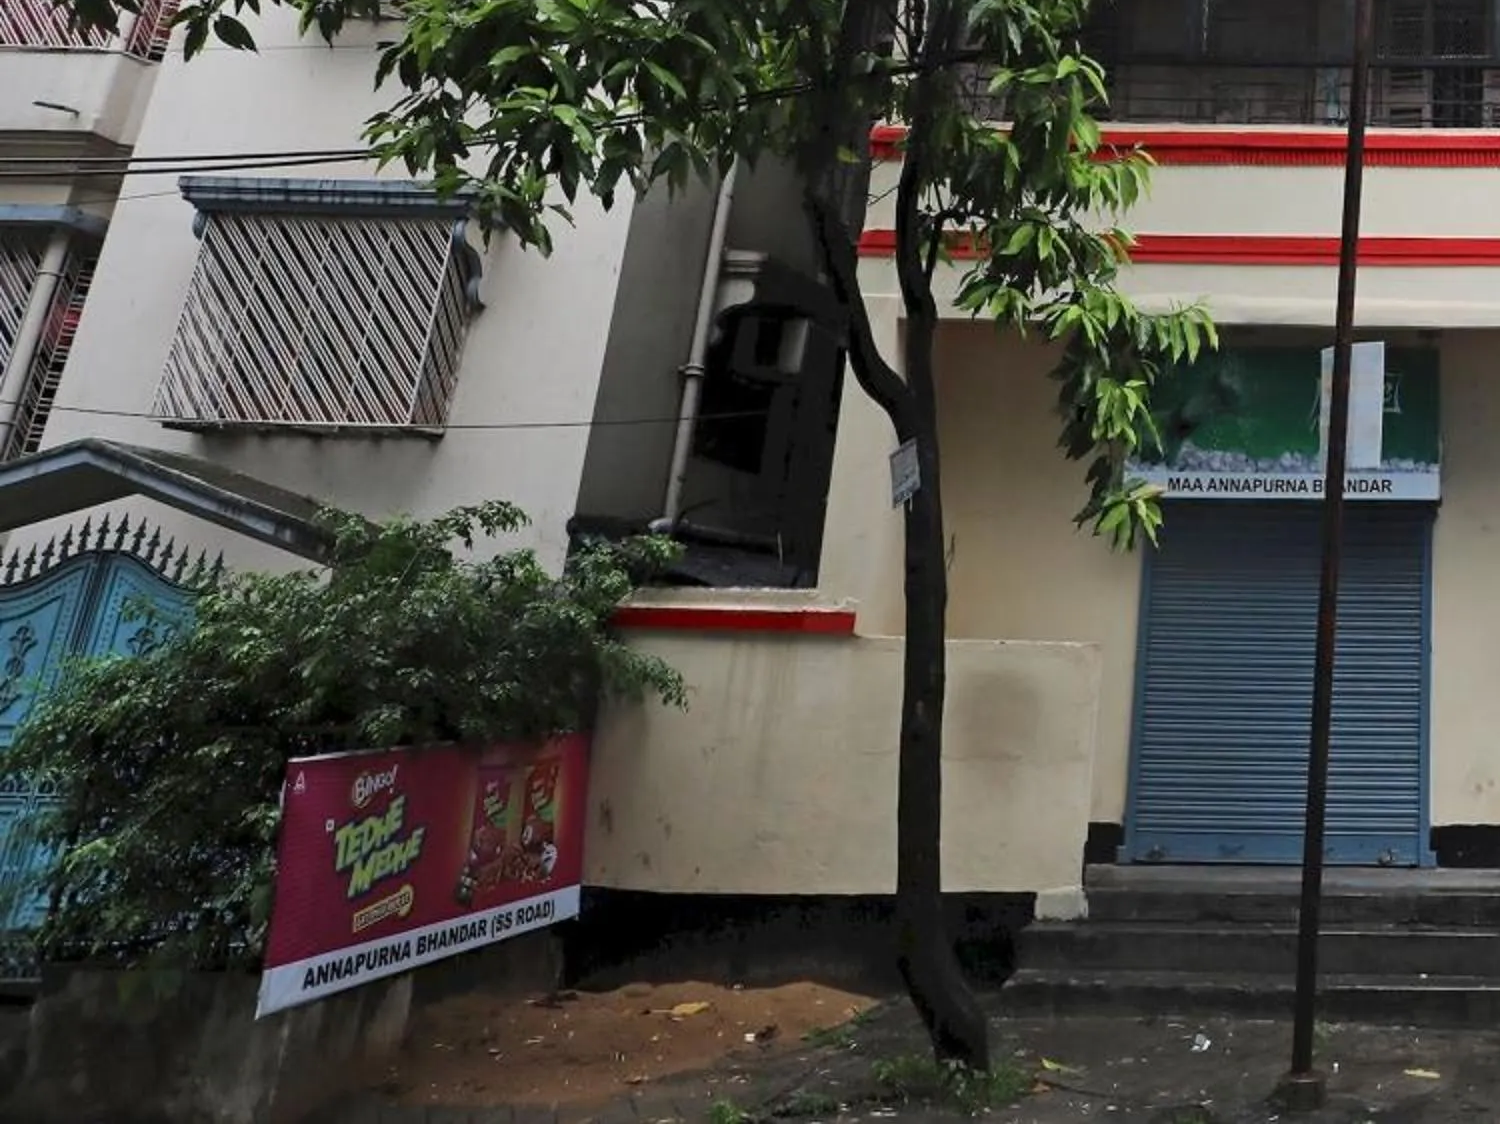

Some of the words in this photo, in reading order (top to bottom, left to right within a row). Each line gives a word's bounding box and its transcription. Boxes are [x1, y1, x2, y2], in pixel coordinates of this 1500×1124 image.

[1167, 477, 1202, 493] MAA
[1207, 478, 1309, 494] ANNAPURNA
[1313, 478, 1393, 494] BNDAR
[335, 795, 406, 872] TEDHE
[348, 827, 426, 898] MEDHE
[303, 939, 411, 989] ANNAPURNA
[415, 923, 487, 957] BHANDAR
[491, 915, 513, 938] (SS
[515, 899, 555, 926] ROAD)
